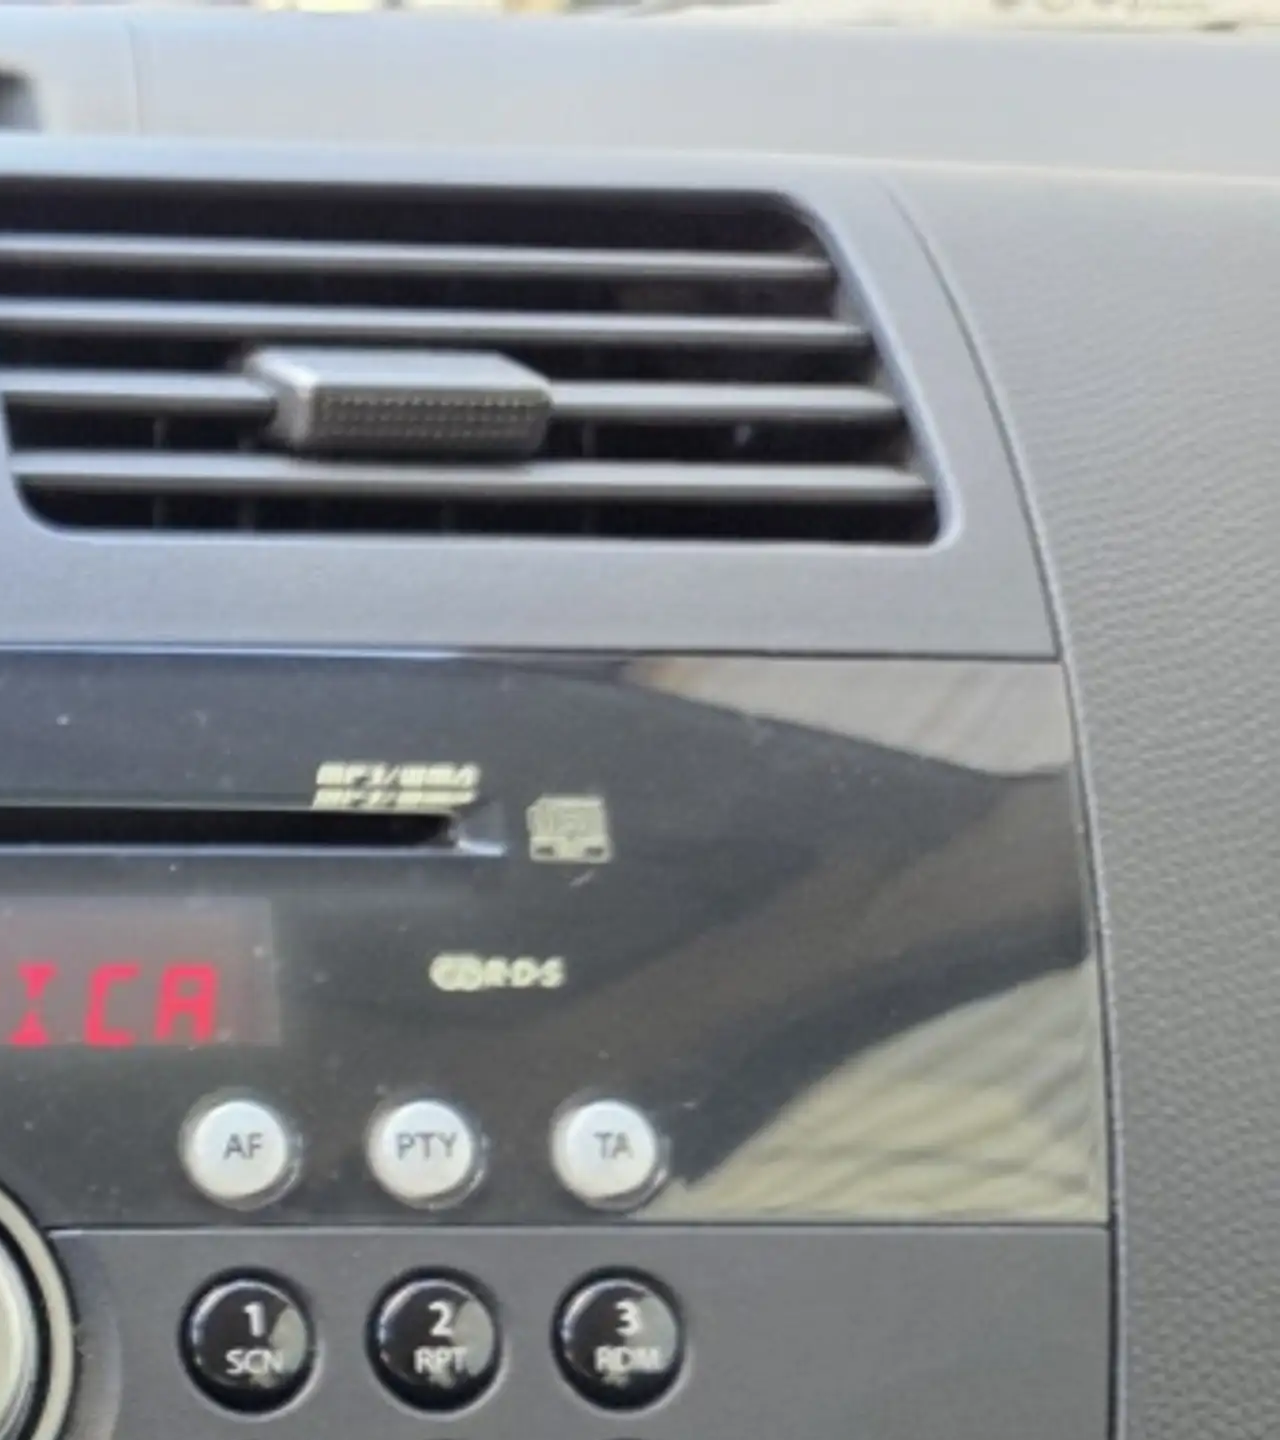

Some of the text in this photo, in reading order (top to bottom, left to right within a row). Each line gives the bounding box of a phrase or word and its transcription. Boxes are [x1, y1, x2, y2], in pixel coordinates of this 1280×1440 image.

[222, 1131, 264, 1161] AF
[395, 1131, 458, 1161] PTY
[592, 1131, 634, 1161] TA
[243, 1301, 266, 1338] 1
[427, 1301, 454, 1338] 2
[614, 1301, 642, 1336] 3
[224, 1348, 284, 1376] SCN
[413, 1346, 468, 1374] RPT
